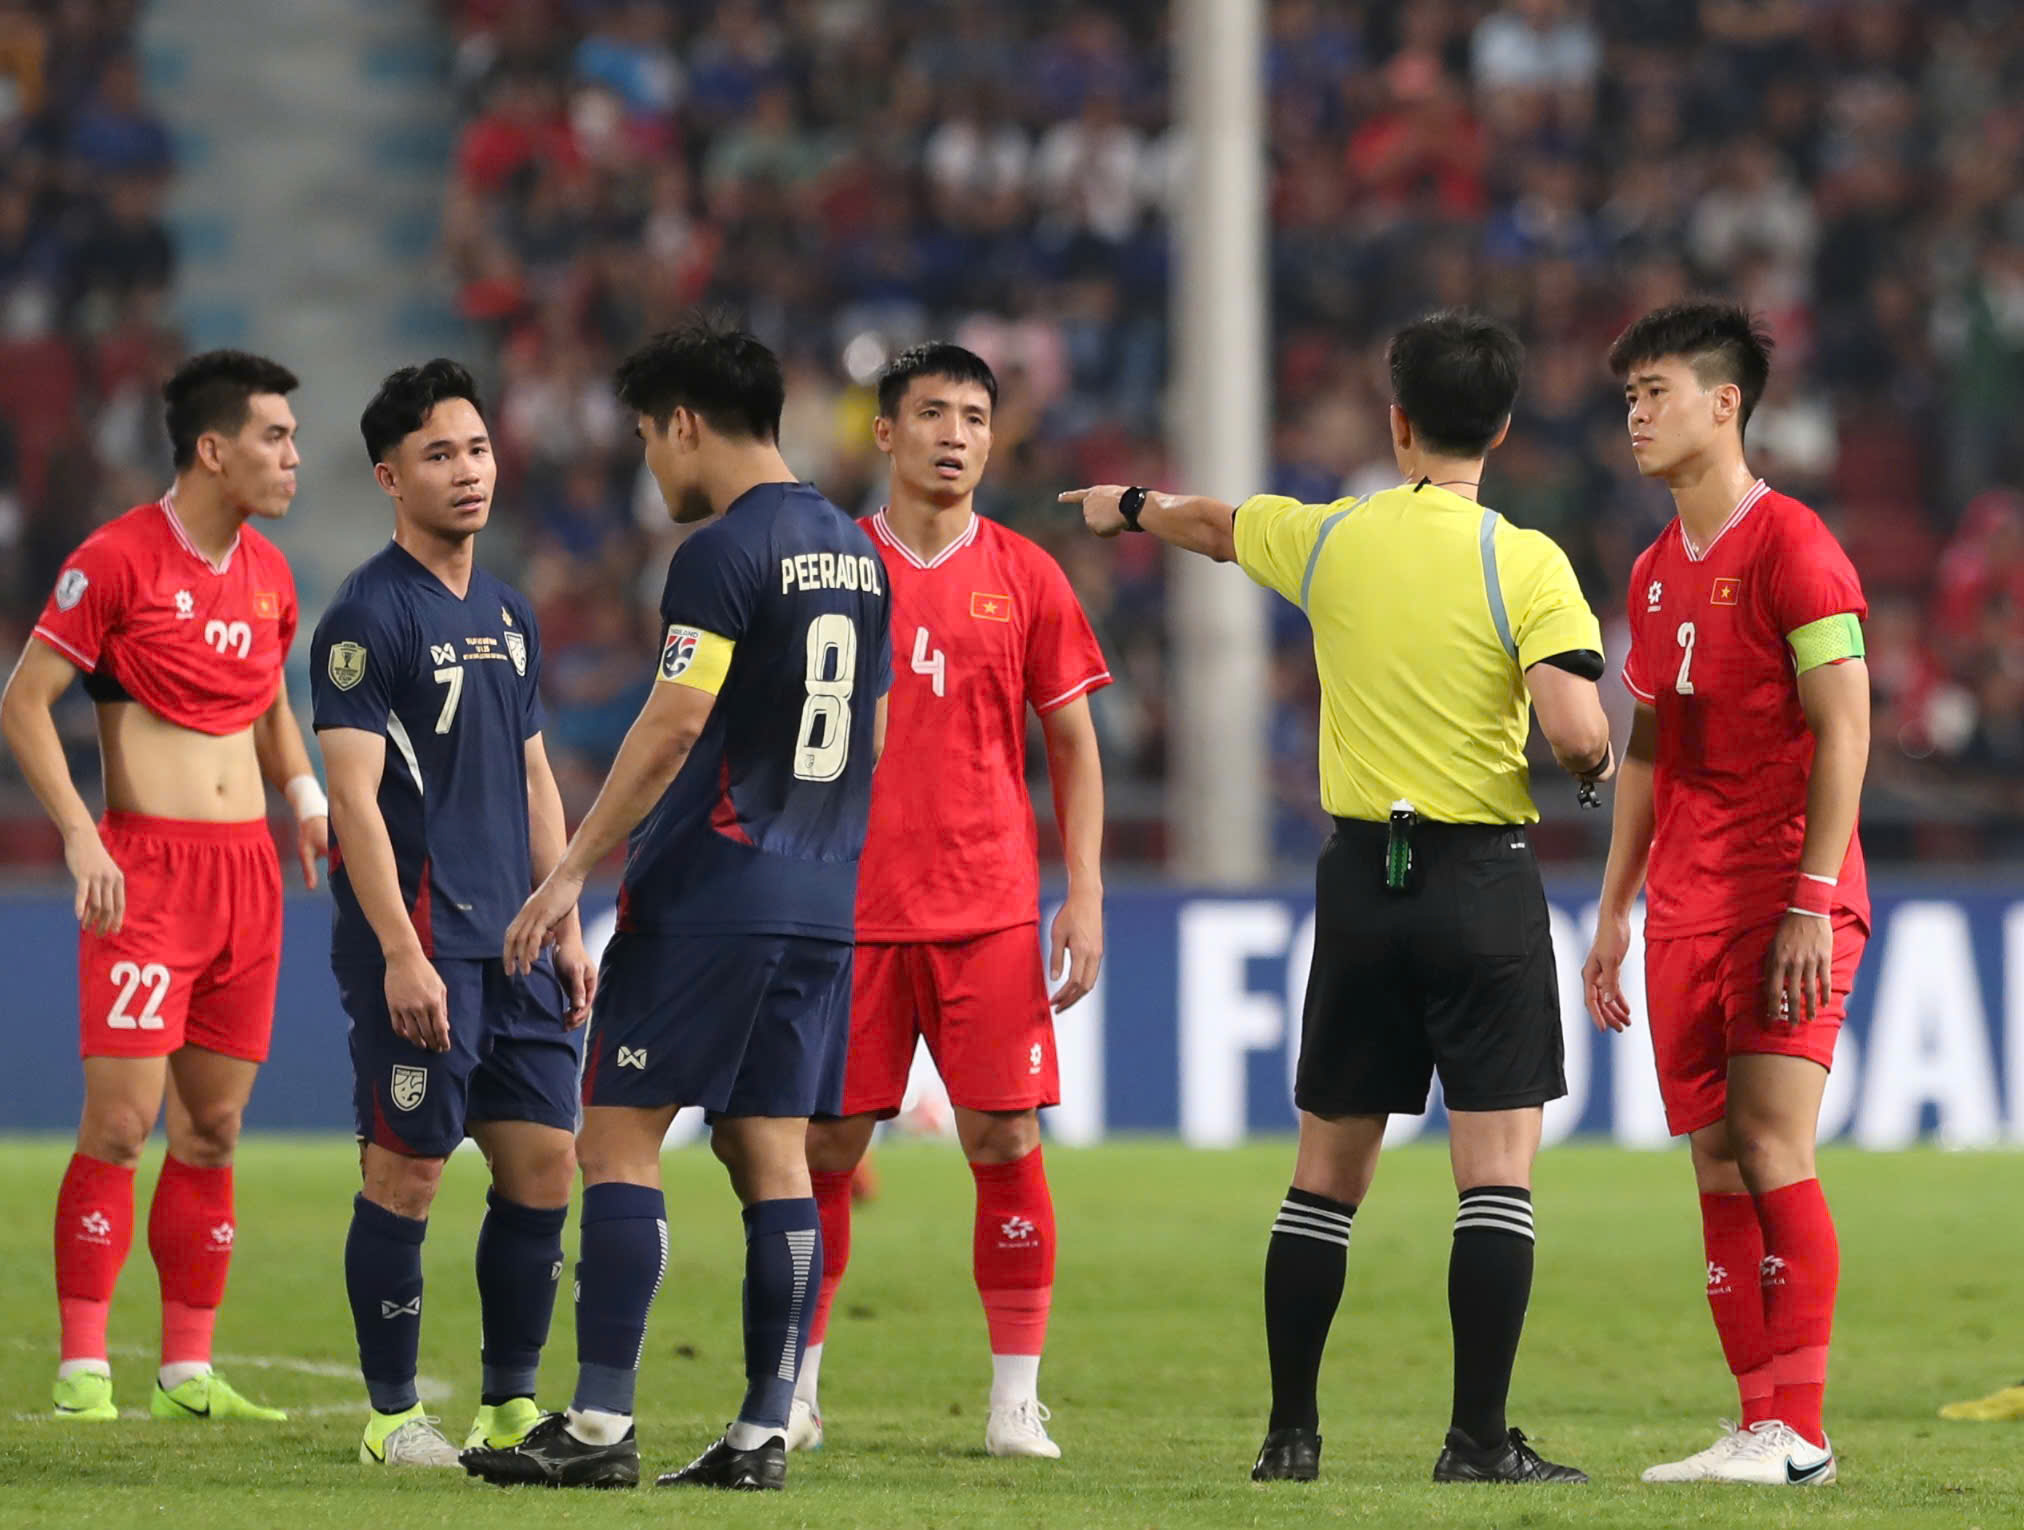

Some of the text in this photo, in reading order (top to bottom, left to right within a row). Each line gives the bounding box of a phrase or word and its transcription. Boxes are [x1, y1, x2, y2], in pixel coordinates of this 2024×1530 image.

[781, 553, 881, 595] PEERADOL
[911, 626, 946, 697] 4
[1675, 621, 1696, 696] 2
[433, 665, 464, 735] 7
[795, 614, 856, 782] 8
[106, 960, 171, 1030] 22
